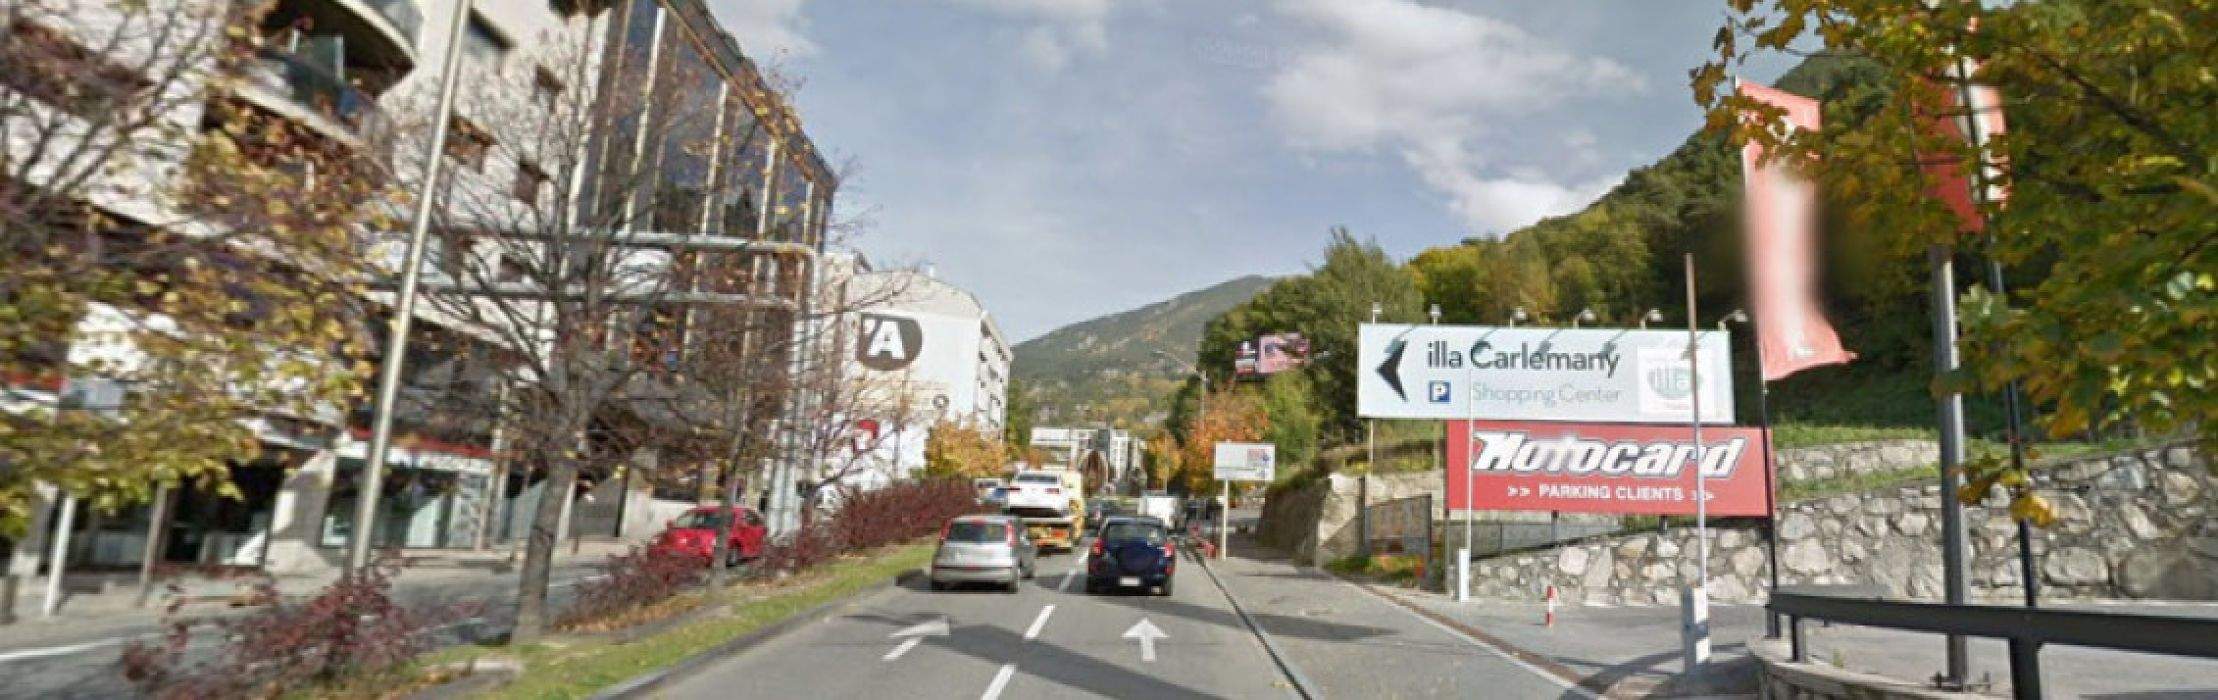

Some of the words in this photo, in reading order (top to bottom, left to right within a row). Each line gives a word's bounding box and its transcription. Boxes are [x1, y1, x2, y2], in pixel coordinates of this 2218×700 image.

[1427, 341, 1463, 369] illa
[1470, 340, 1621, 378] Carlemany
[1471, 382, 1556, 407] Shopping
[1558, 383, 1619, 401] Center
[1473, 430, 1747, 479] Motocard
[1538, 483, 1611, 499] PARKING
[1615, 485, 1683, 500] CLIENTS
